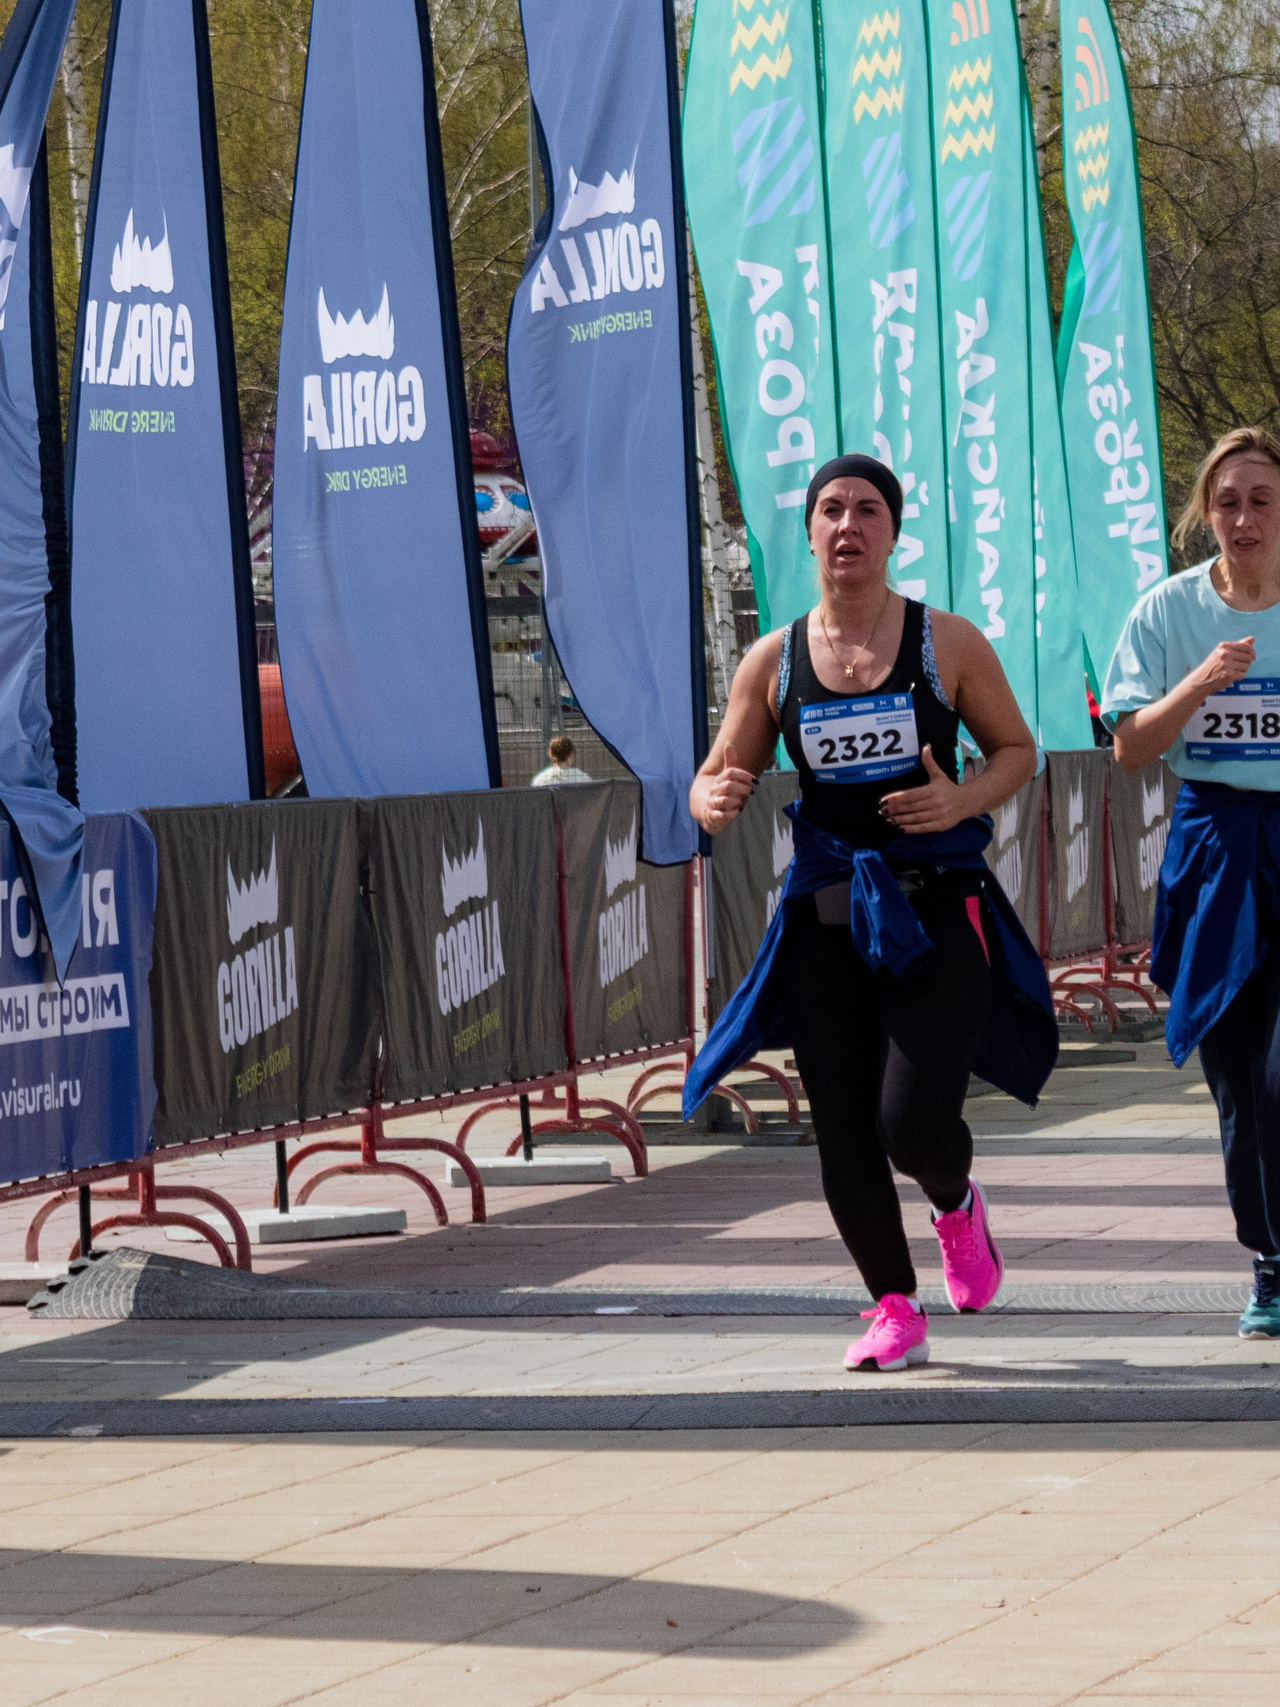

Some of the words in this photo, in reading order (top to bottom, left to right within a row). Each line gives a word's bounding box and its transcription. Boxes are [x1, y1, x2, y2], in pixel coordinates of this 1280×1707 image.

[818, 729, 904, 765] 2322
[217, 924, 299, 1054] GORILLA
[435, 899, 506, 1016] GORILLA
